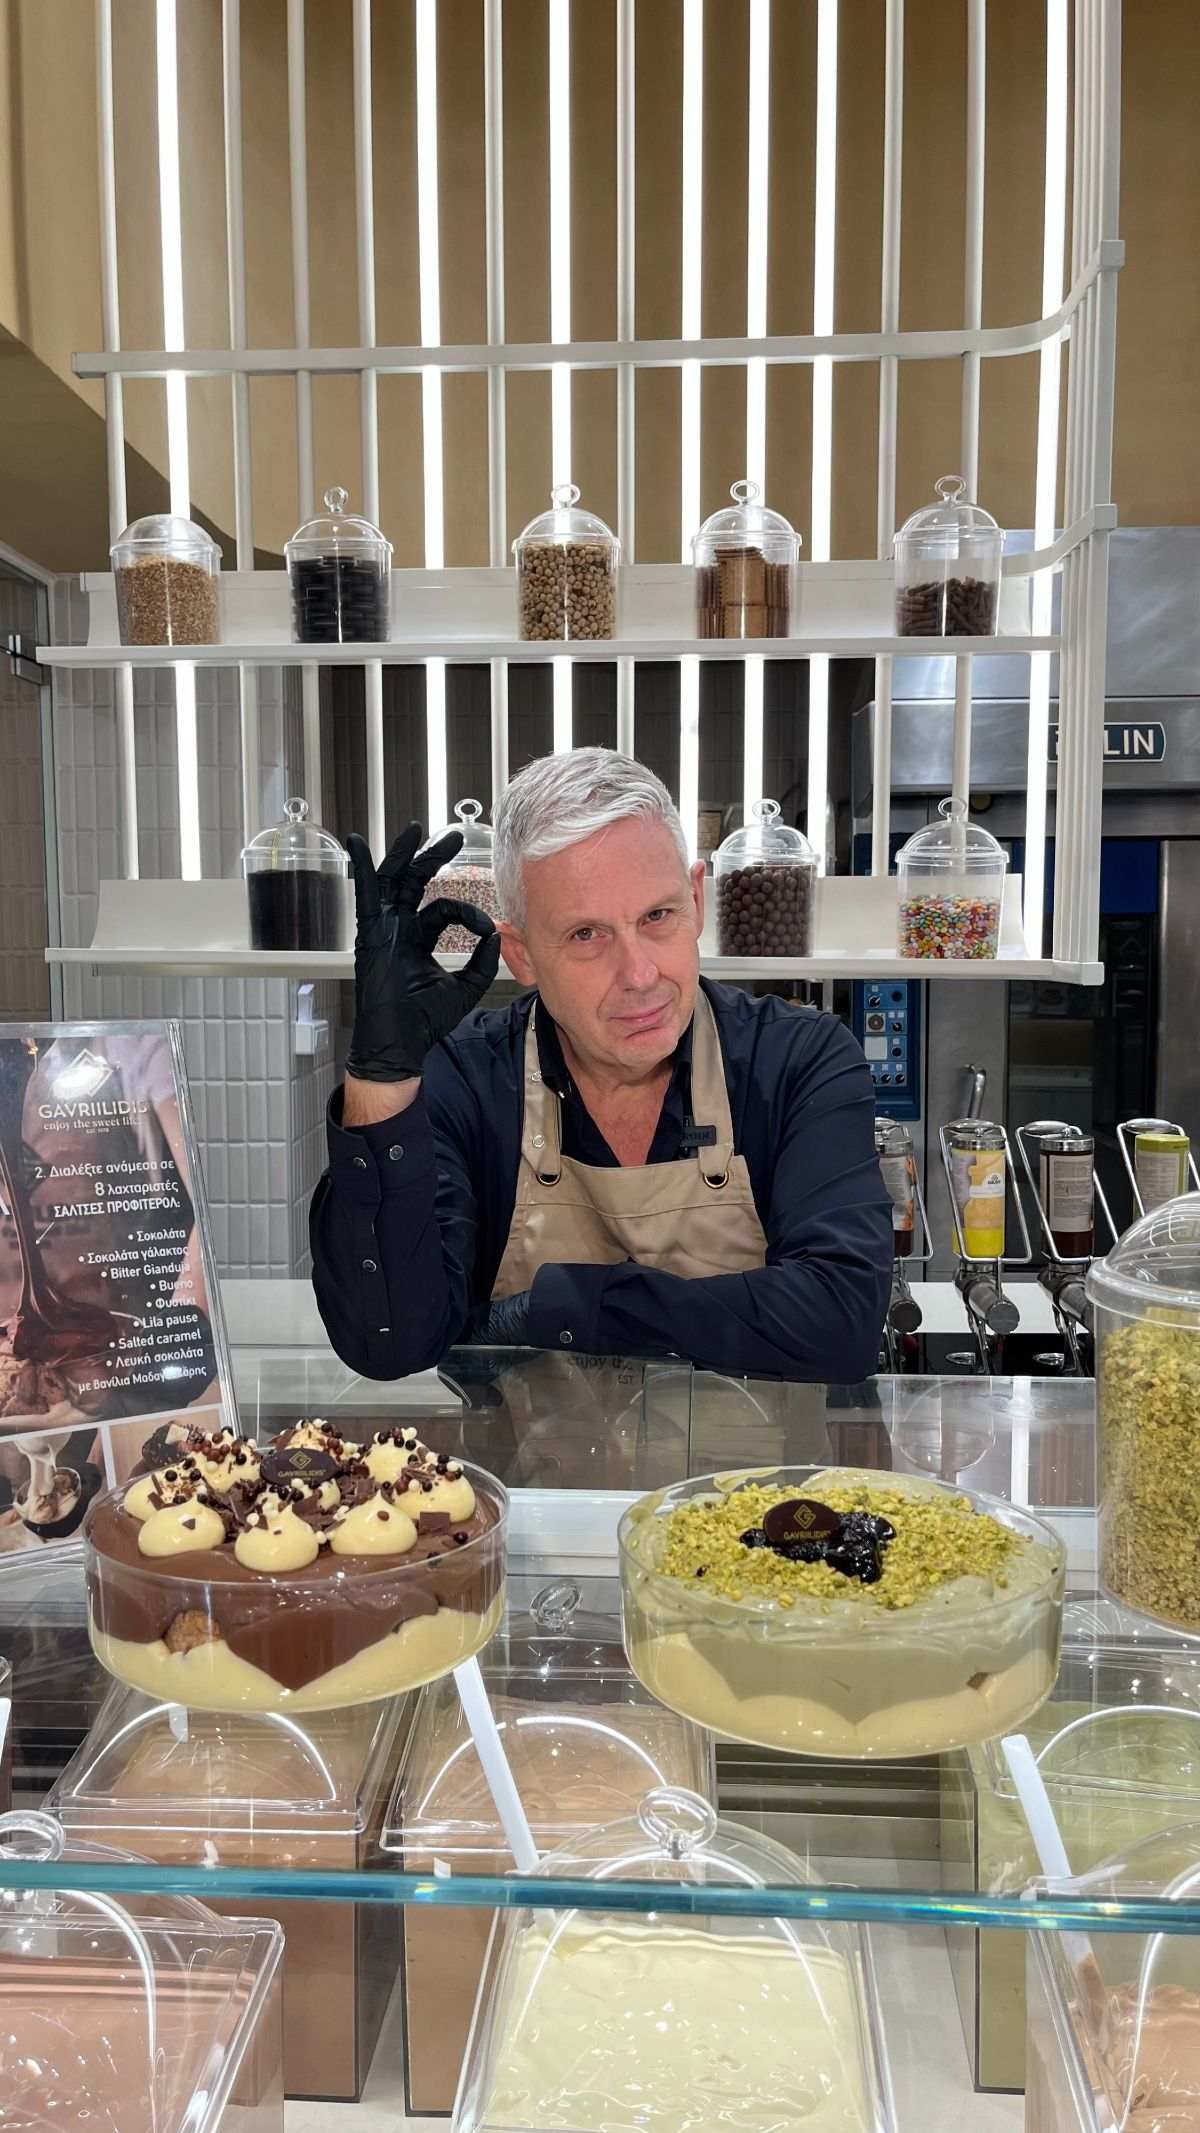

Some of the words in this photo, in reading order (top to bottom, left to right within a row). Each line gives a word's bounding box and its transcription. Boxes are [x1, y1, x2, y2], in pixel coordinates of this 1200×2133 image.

[73, 1118, 91, 1129] the
[34, 1166, 47, 1179] 2.
[49, 1162, 103, 1178] Διαλέξτε
[105, 1160, 158, 1174] ανάμεσα
[160, 1161, 175, 1169] σε
[95, 1182, 105, 1197] 8
[108, 1180, 179, 1196] λαχταριστές
[54, 1202, 105, 1218] ΣΑΛΤΣΕΣ
[107, 1197, 181, 1213] ΠΡΟΦΙΤΕΡΟΛ:
[136, 1228, 186, 1242] Σοκολάτα
[87, 1249, 139, 1264] Σοκολάτα
[140, 1245, 192, 1261] γάλακτος
[110, 1266, 141, 1279] Bitter
[143, 1261, 191, 1276] Gianduja
[159, 1279, 193, 1292] Bueno
[142, 1315, 164, 1329] Lila
[165, 1313, 199, 1328] pause
[118, 1334, 155, 1350] Salted
[156, 1328, 202, 1345] caramel
[115, 1352, 152, 1369] Λευκή
[154, 1346, 204, 1363] σοκολάτα
[78, 1381, 93, 1394] με
[132, 1366, 207, 1385] Μαδαγάρης
